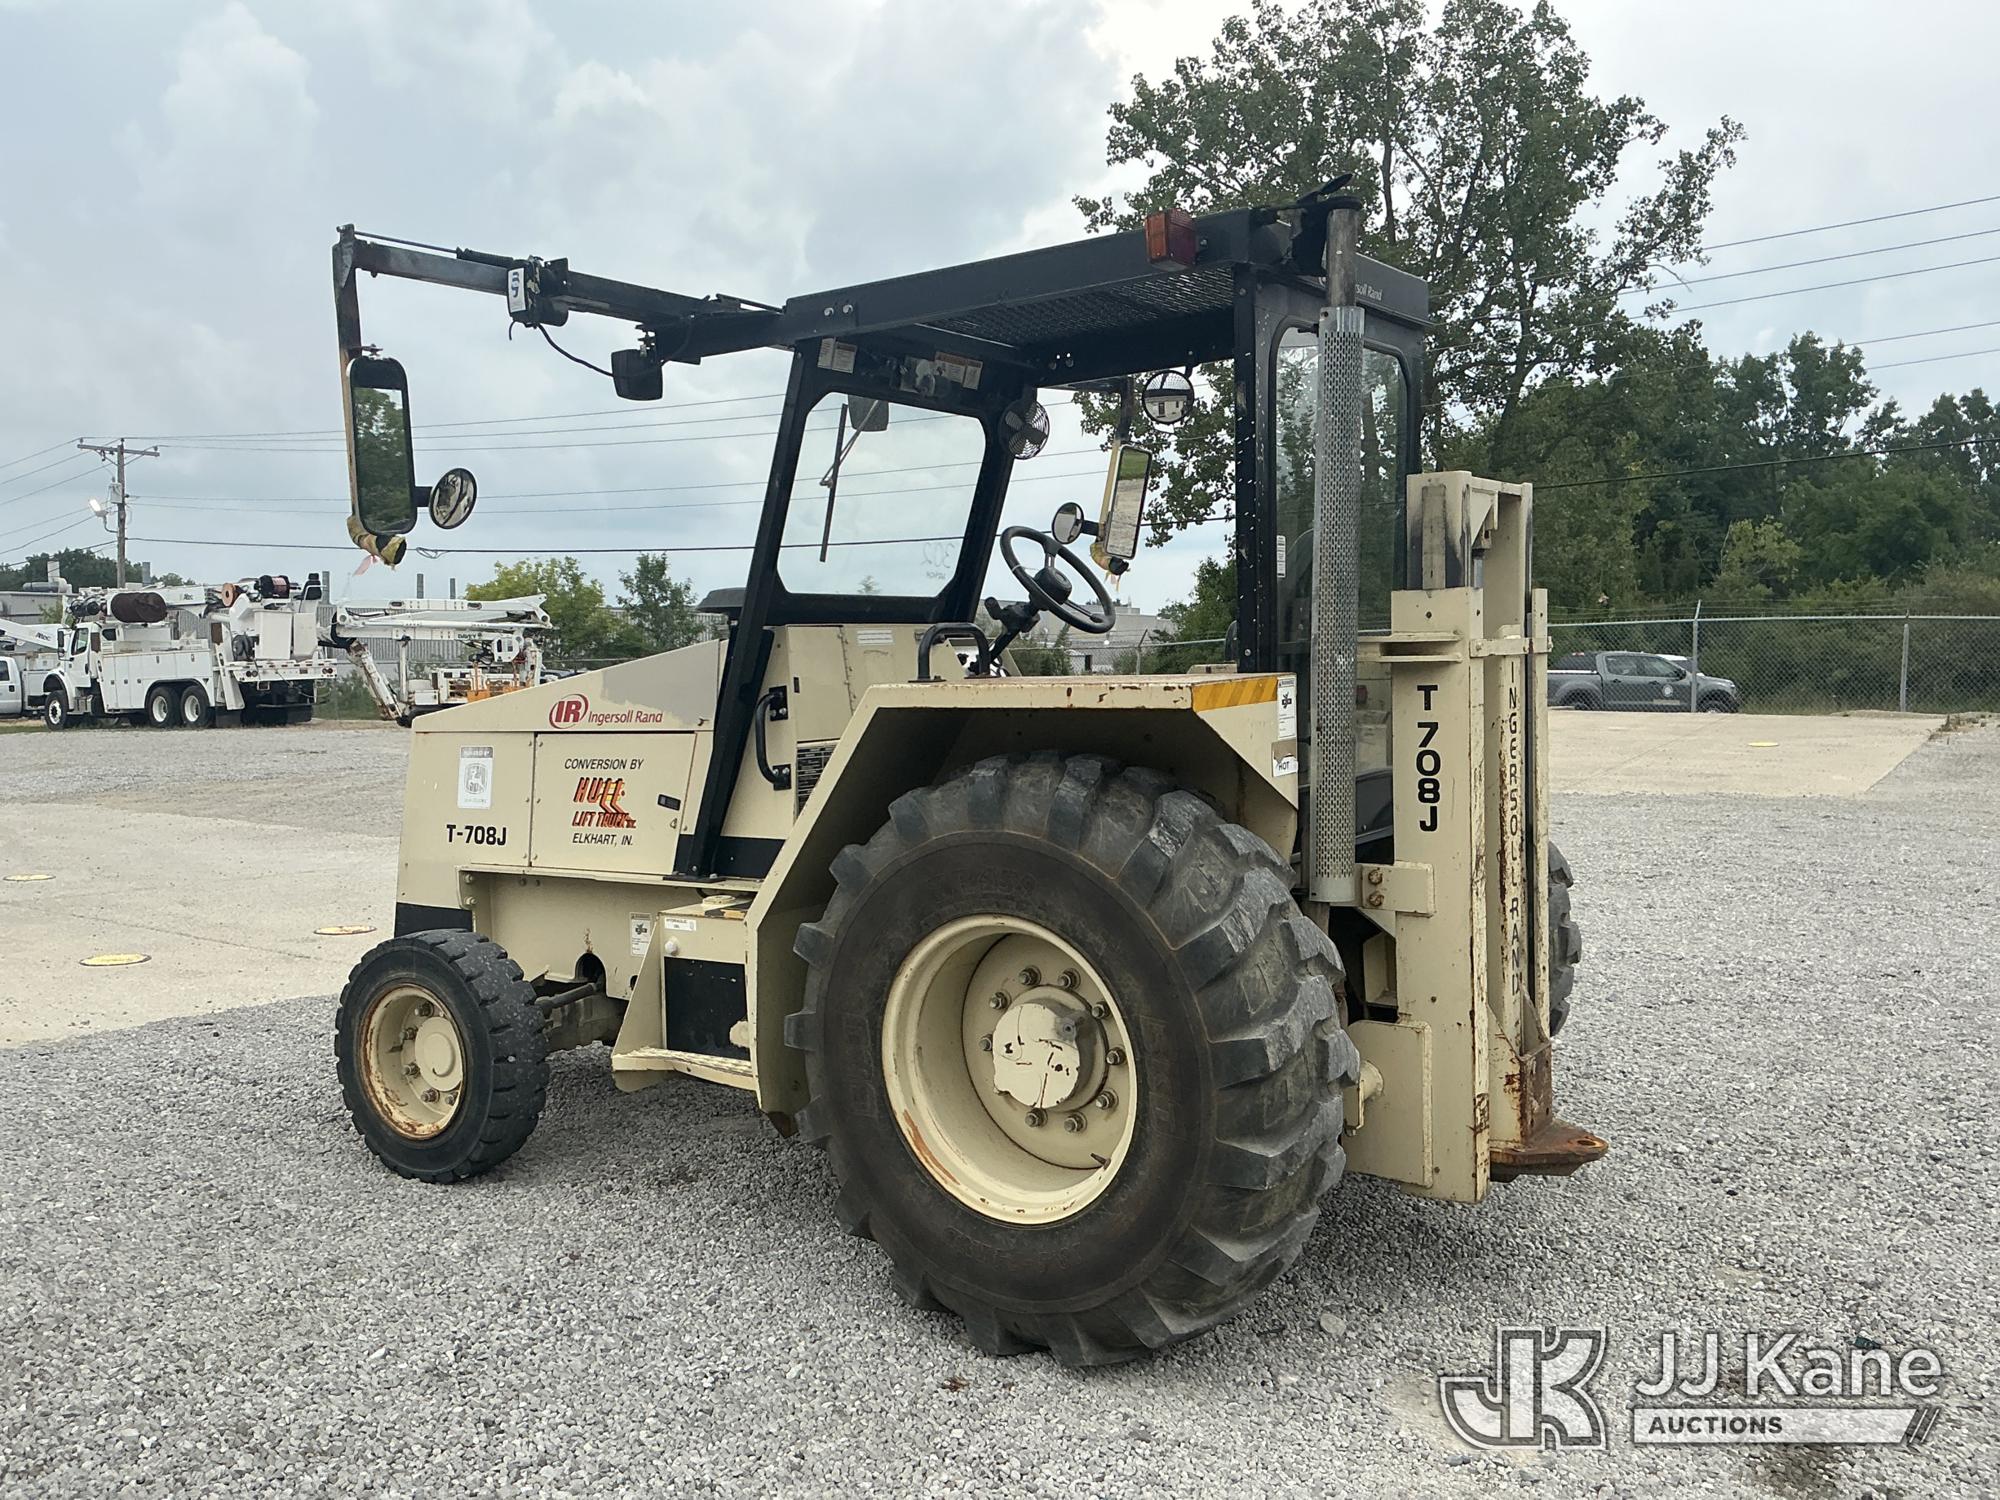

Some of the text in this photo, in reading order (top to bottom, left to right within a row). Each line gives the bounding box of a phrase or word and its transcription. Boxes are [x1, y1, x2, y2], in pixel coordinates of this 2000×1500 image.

[588, 709, 663, 726] Ingersoll Rand
[564, 758, 645, 770] CONVERSION BY
[446, 823, 507, 846] T-708J
[1508, 661, 1520, 996] INGERSOLL RAND
[572, 833, 633, 847] ELKHART, IN.
